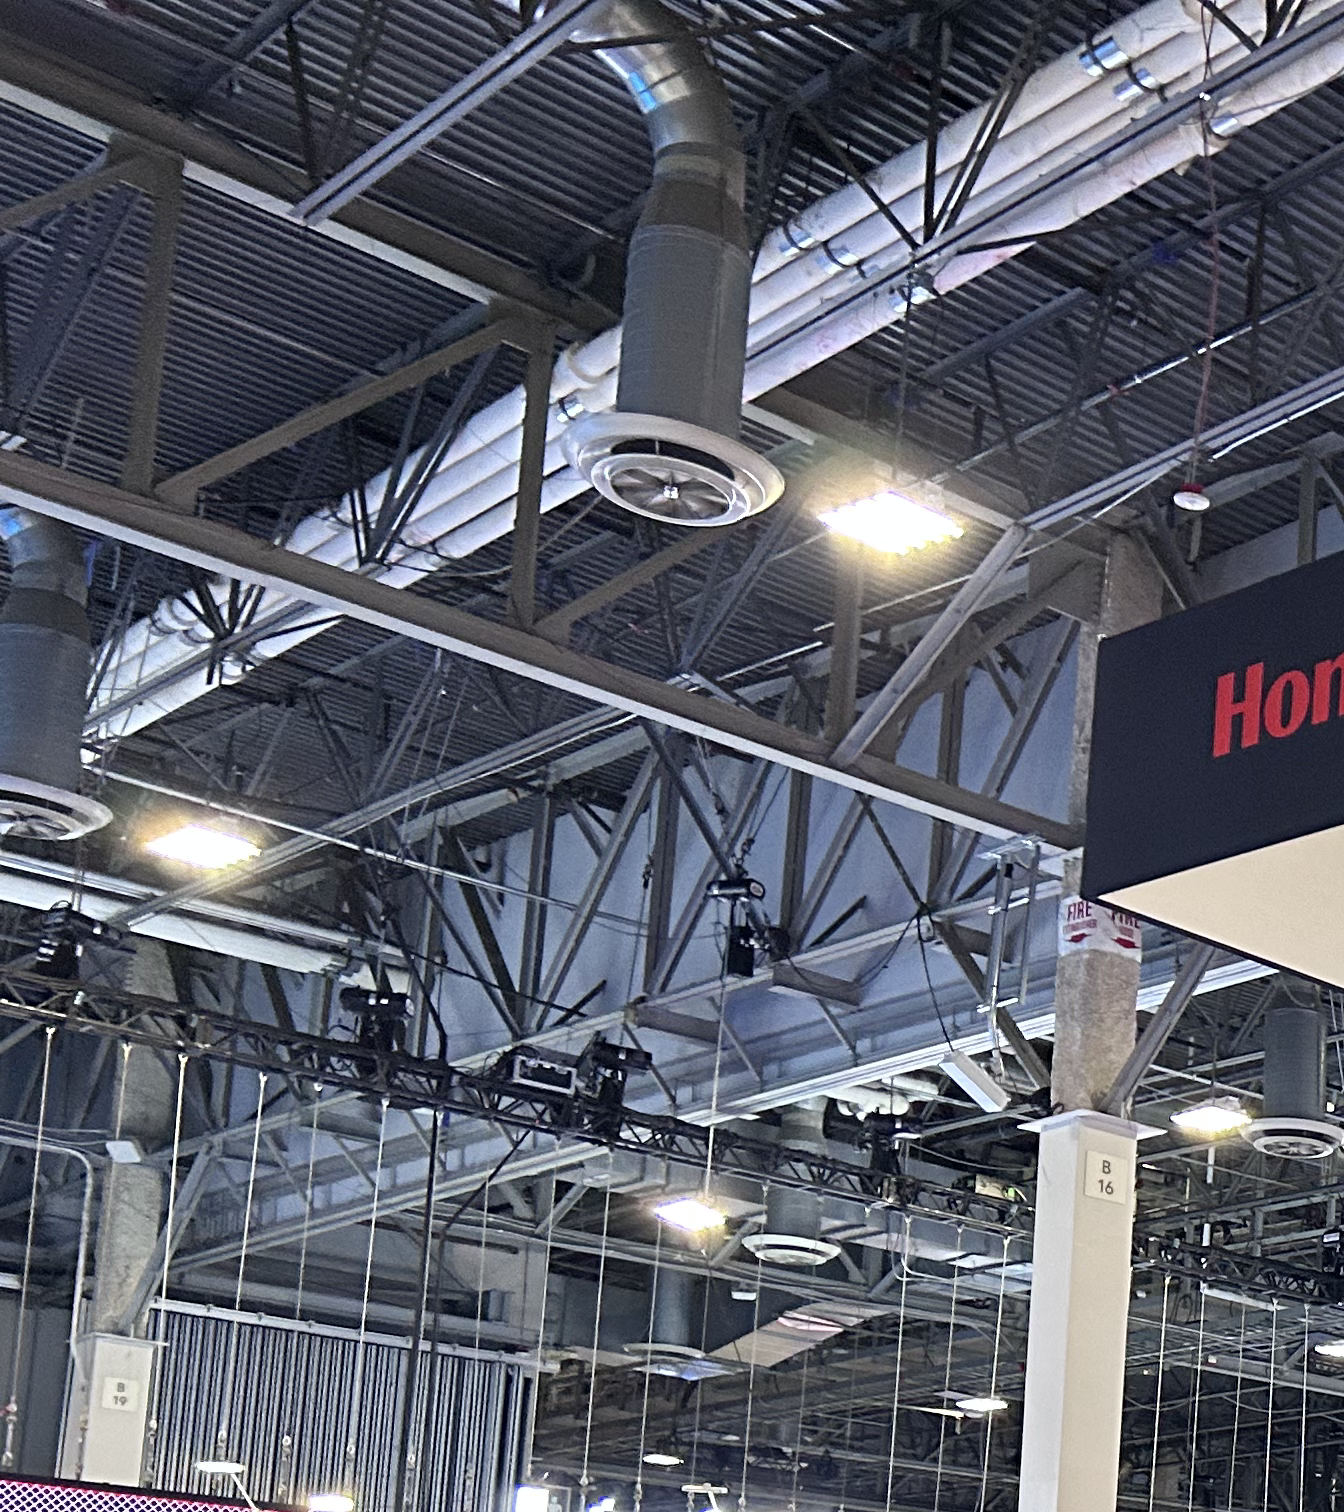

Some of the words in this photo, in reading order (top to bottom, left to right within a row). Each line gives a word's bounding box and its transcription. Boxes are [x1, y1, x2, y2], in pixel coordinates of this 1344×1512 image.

[1068, 901, 1093, 922] FIRE
[1102, 1160, 1111, 1174] B
[1098, 1179, 1114, 1195] 16
